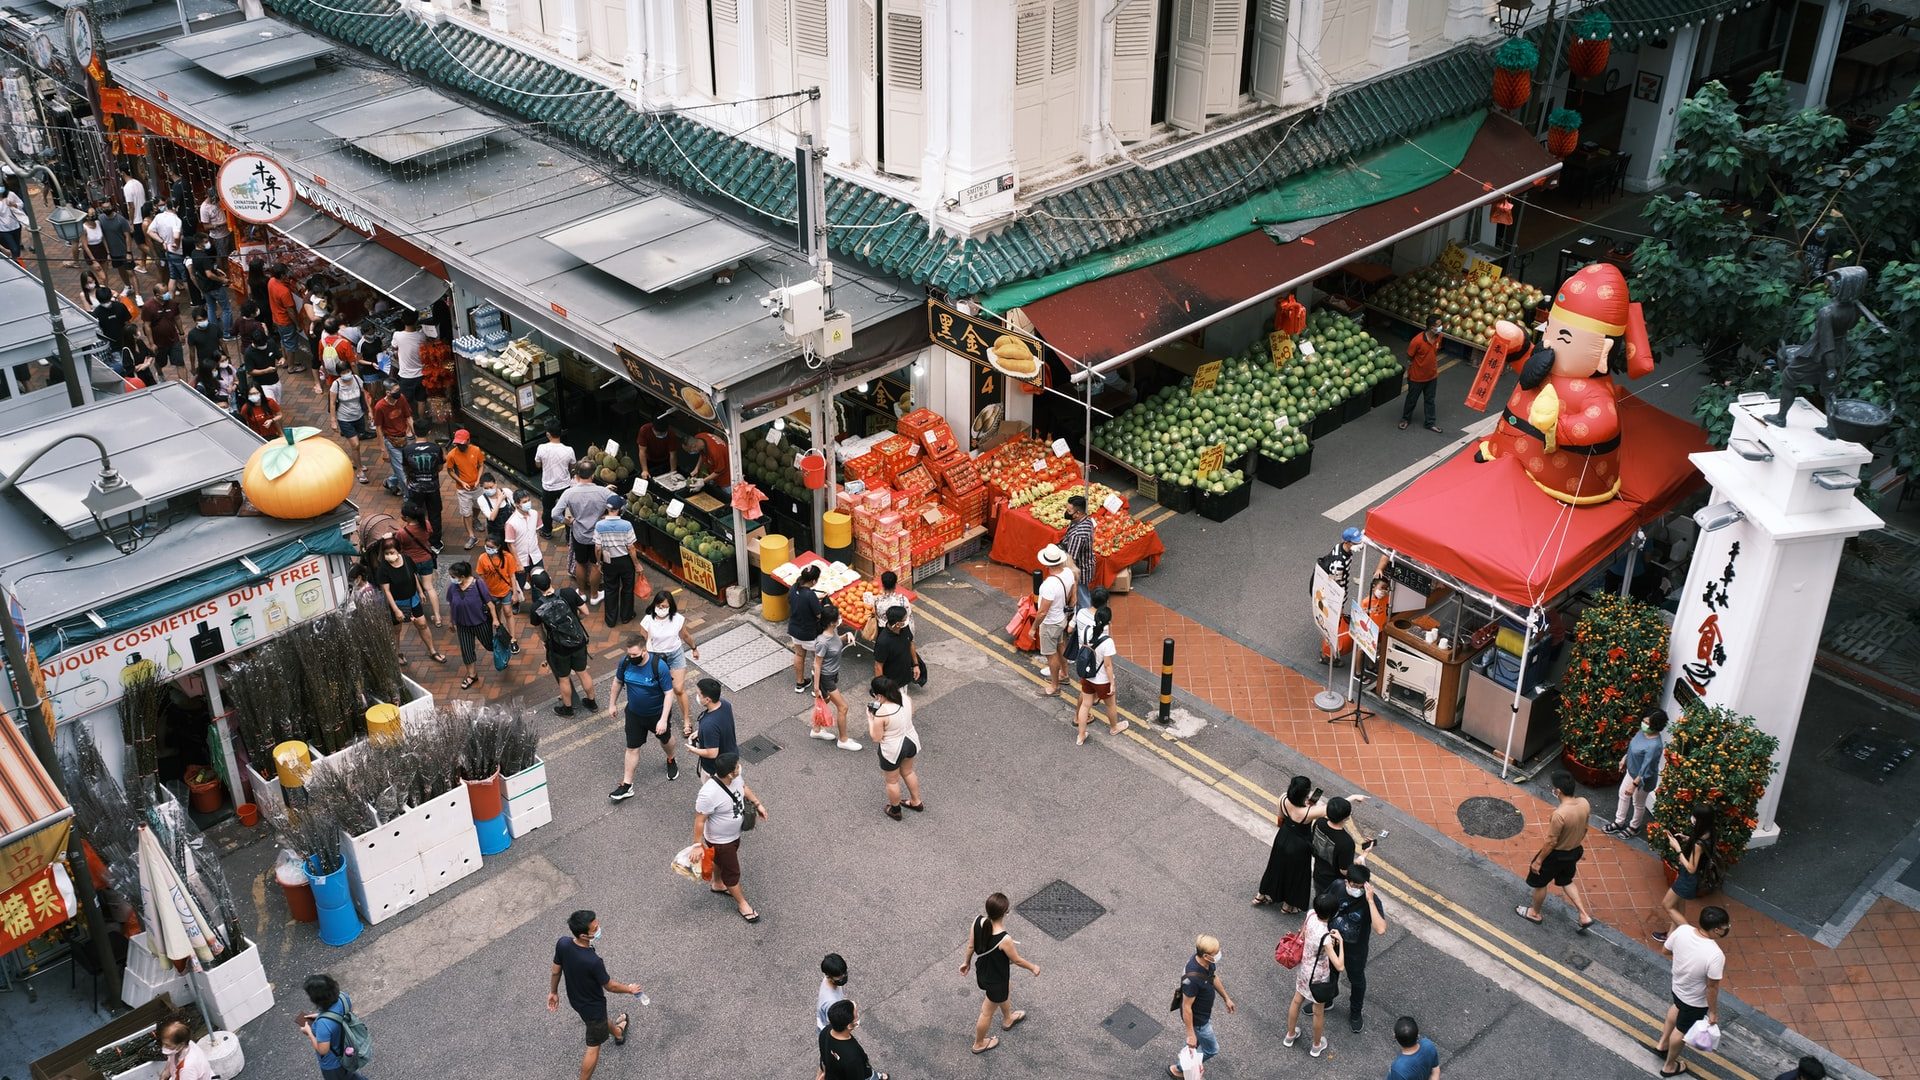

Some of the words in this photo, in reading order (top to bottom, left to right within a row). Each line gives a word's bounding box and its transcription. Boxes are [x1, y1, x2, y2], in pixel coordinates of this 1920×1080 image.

[252, 160, 282, 214] 牛车水
[937, 313, 989, 356] 黑金
[40, 644, 110, 681] NJOUR
[113, 601, 218, 652] COSMETICS
[227, 579, 275, 608] DUTY
[280, 560, 321, 587] FREE
[0, 877, 62, 940] 糖果
